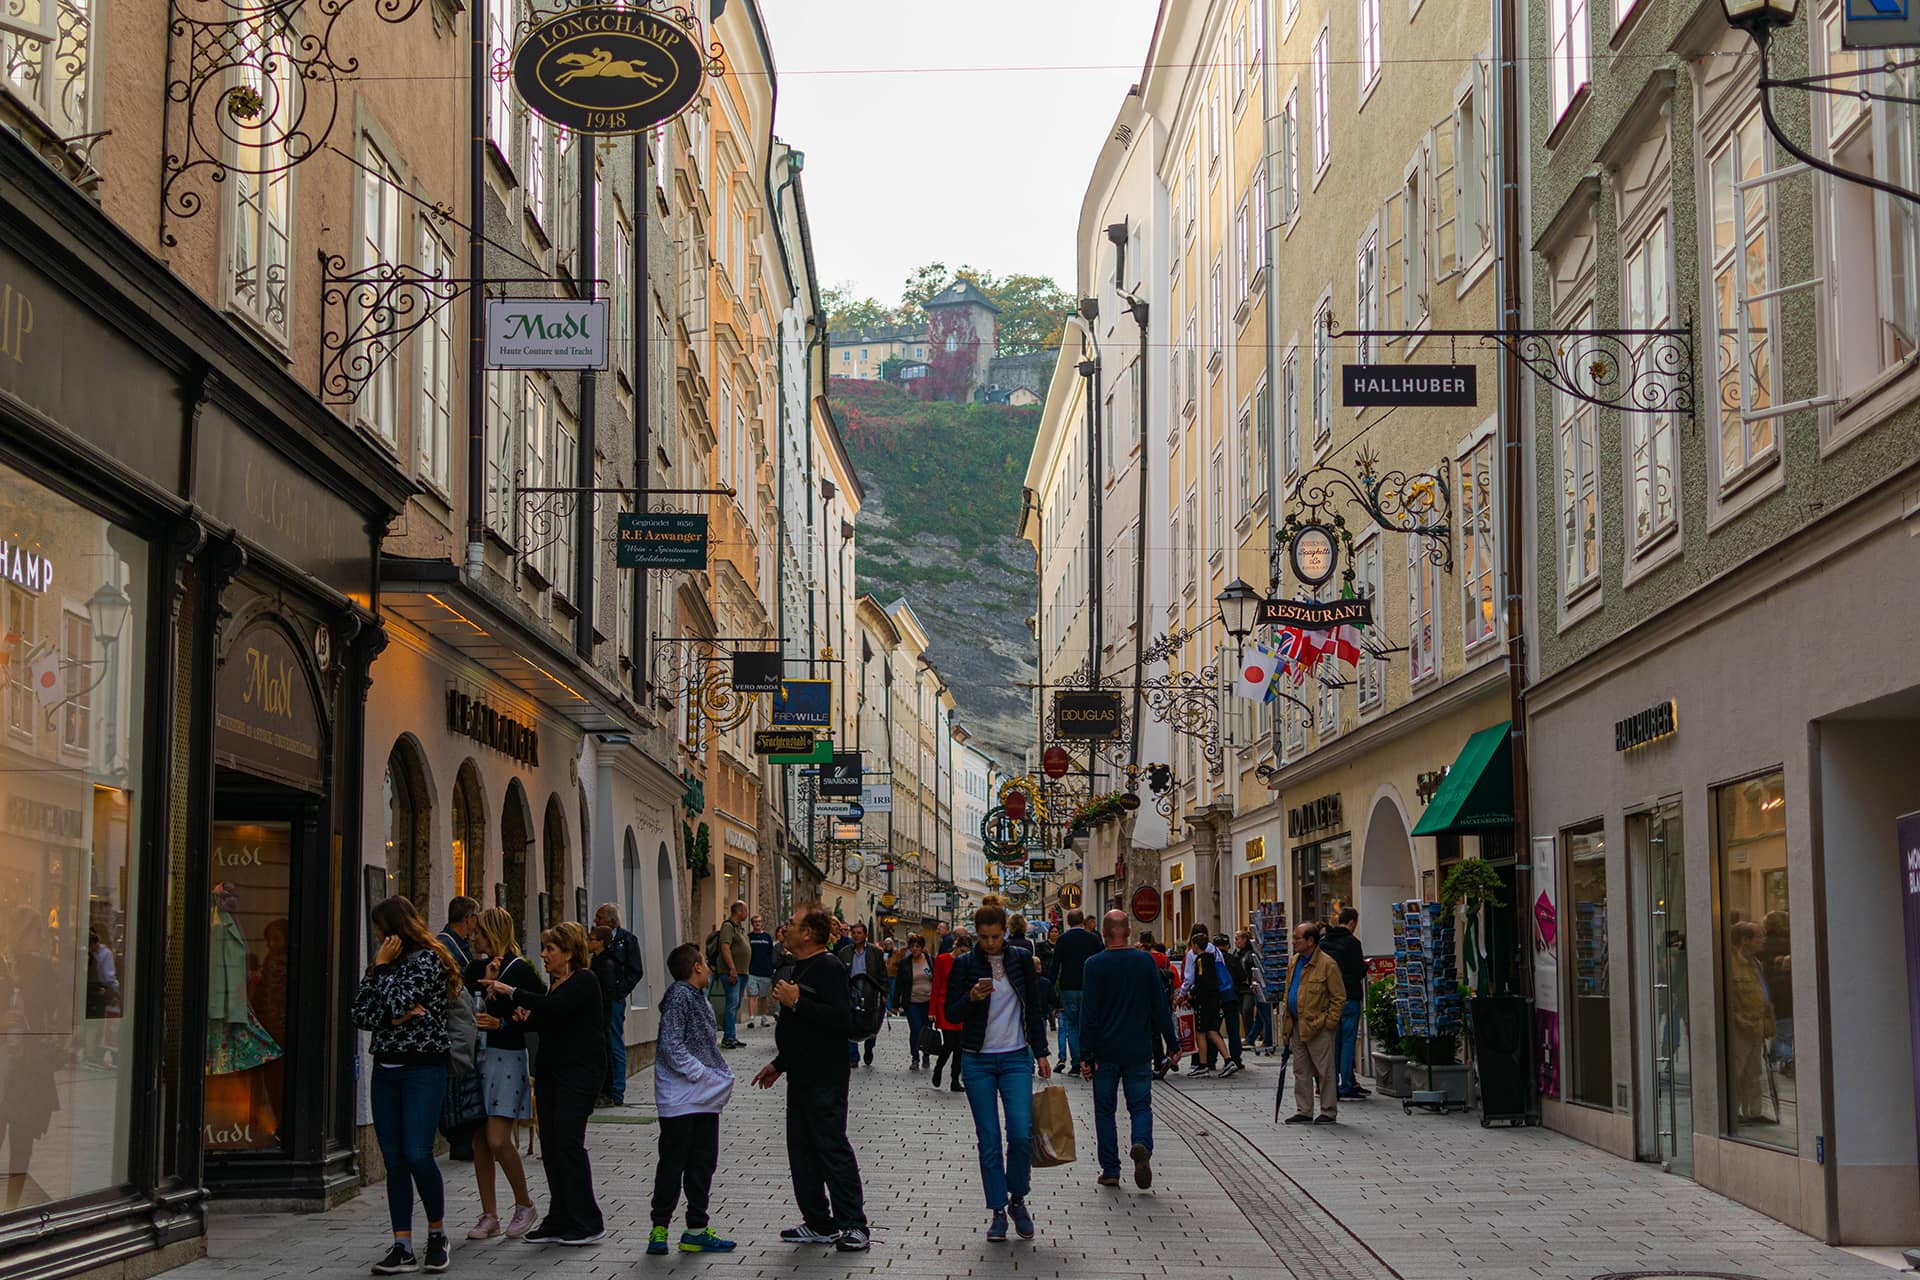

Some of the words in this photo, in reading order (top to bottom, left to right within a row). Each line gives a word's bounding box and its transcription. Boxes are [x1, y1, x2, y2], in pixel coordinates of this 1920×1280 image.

[537, 14, 681, 48] LONGCHAMP
[586, 111, 627, 129] 1948
[503, 312, 591, 340] Madl
[500, 346, 522, 355] Haute
[523, 346, 552, 355] Couture
[554, 346, 569, 355] und
[571, 346, 593, 355] Tracht
[1354, 379, 1466, 393] HALLHUBER
[645, 529, 702, 543] Azwanger
[1266, 605, 1366, 622] RESTAURANT
[243, 647, 294, 720] Madl
[774, 712, 829, 721] FREYWILLE
[1061, 709, 1115, 721] DOUGLAS
[1615, 701, 1673, 751] HALLHUBER
